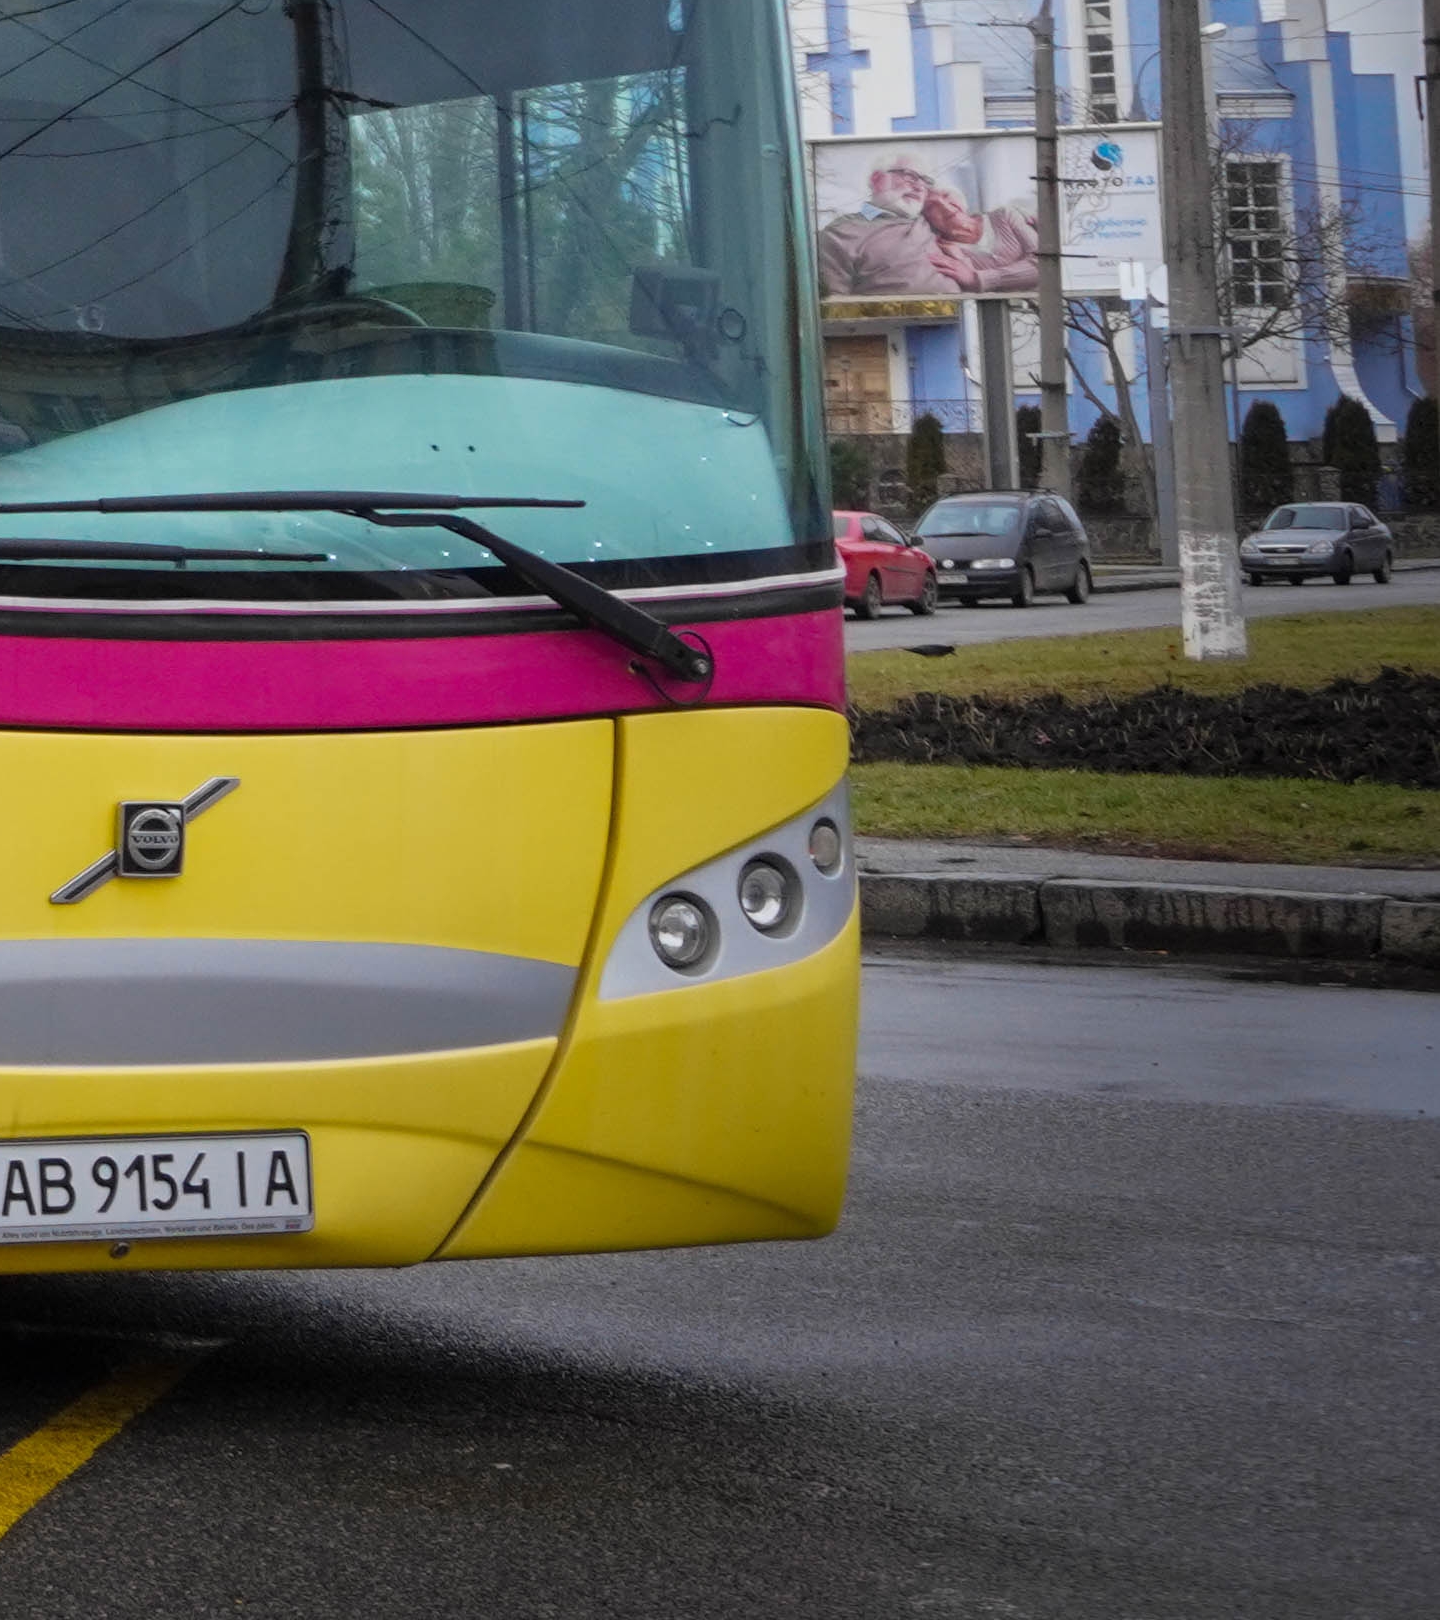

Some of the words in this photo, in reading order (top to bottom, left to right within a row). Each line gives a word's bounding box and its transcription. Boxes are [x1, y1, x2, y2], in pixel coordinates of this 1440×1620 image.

[131, 835, 178, 844] VOLVO
[1, 1157, 76, 1217] AB
[91, 1152, 211, 1214] 9154
[237, 1150, 299, 1208] IA
